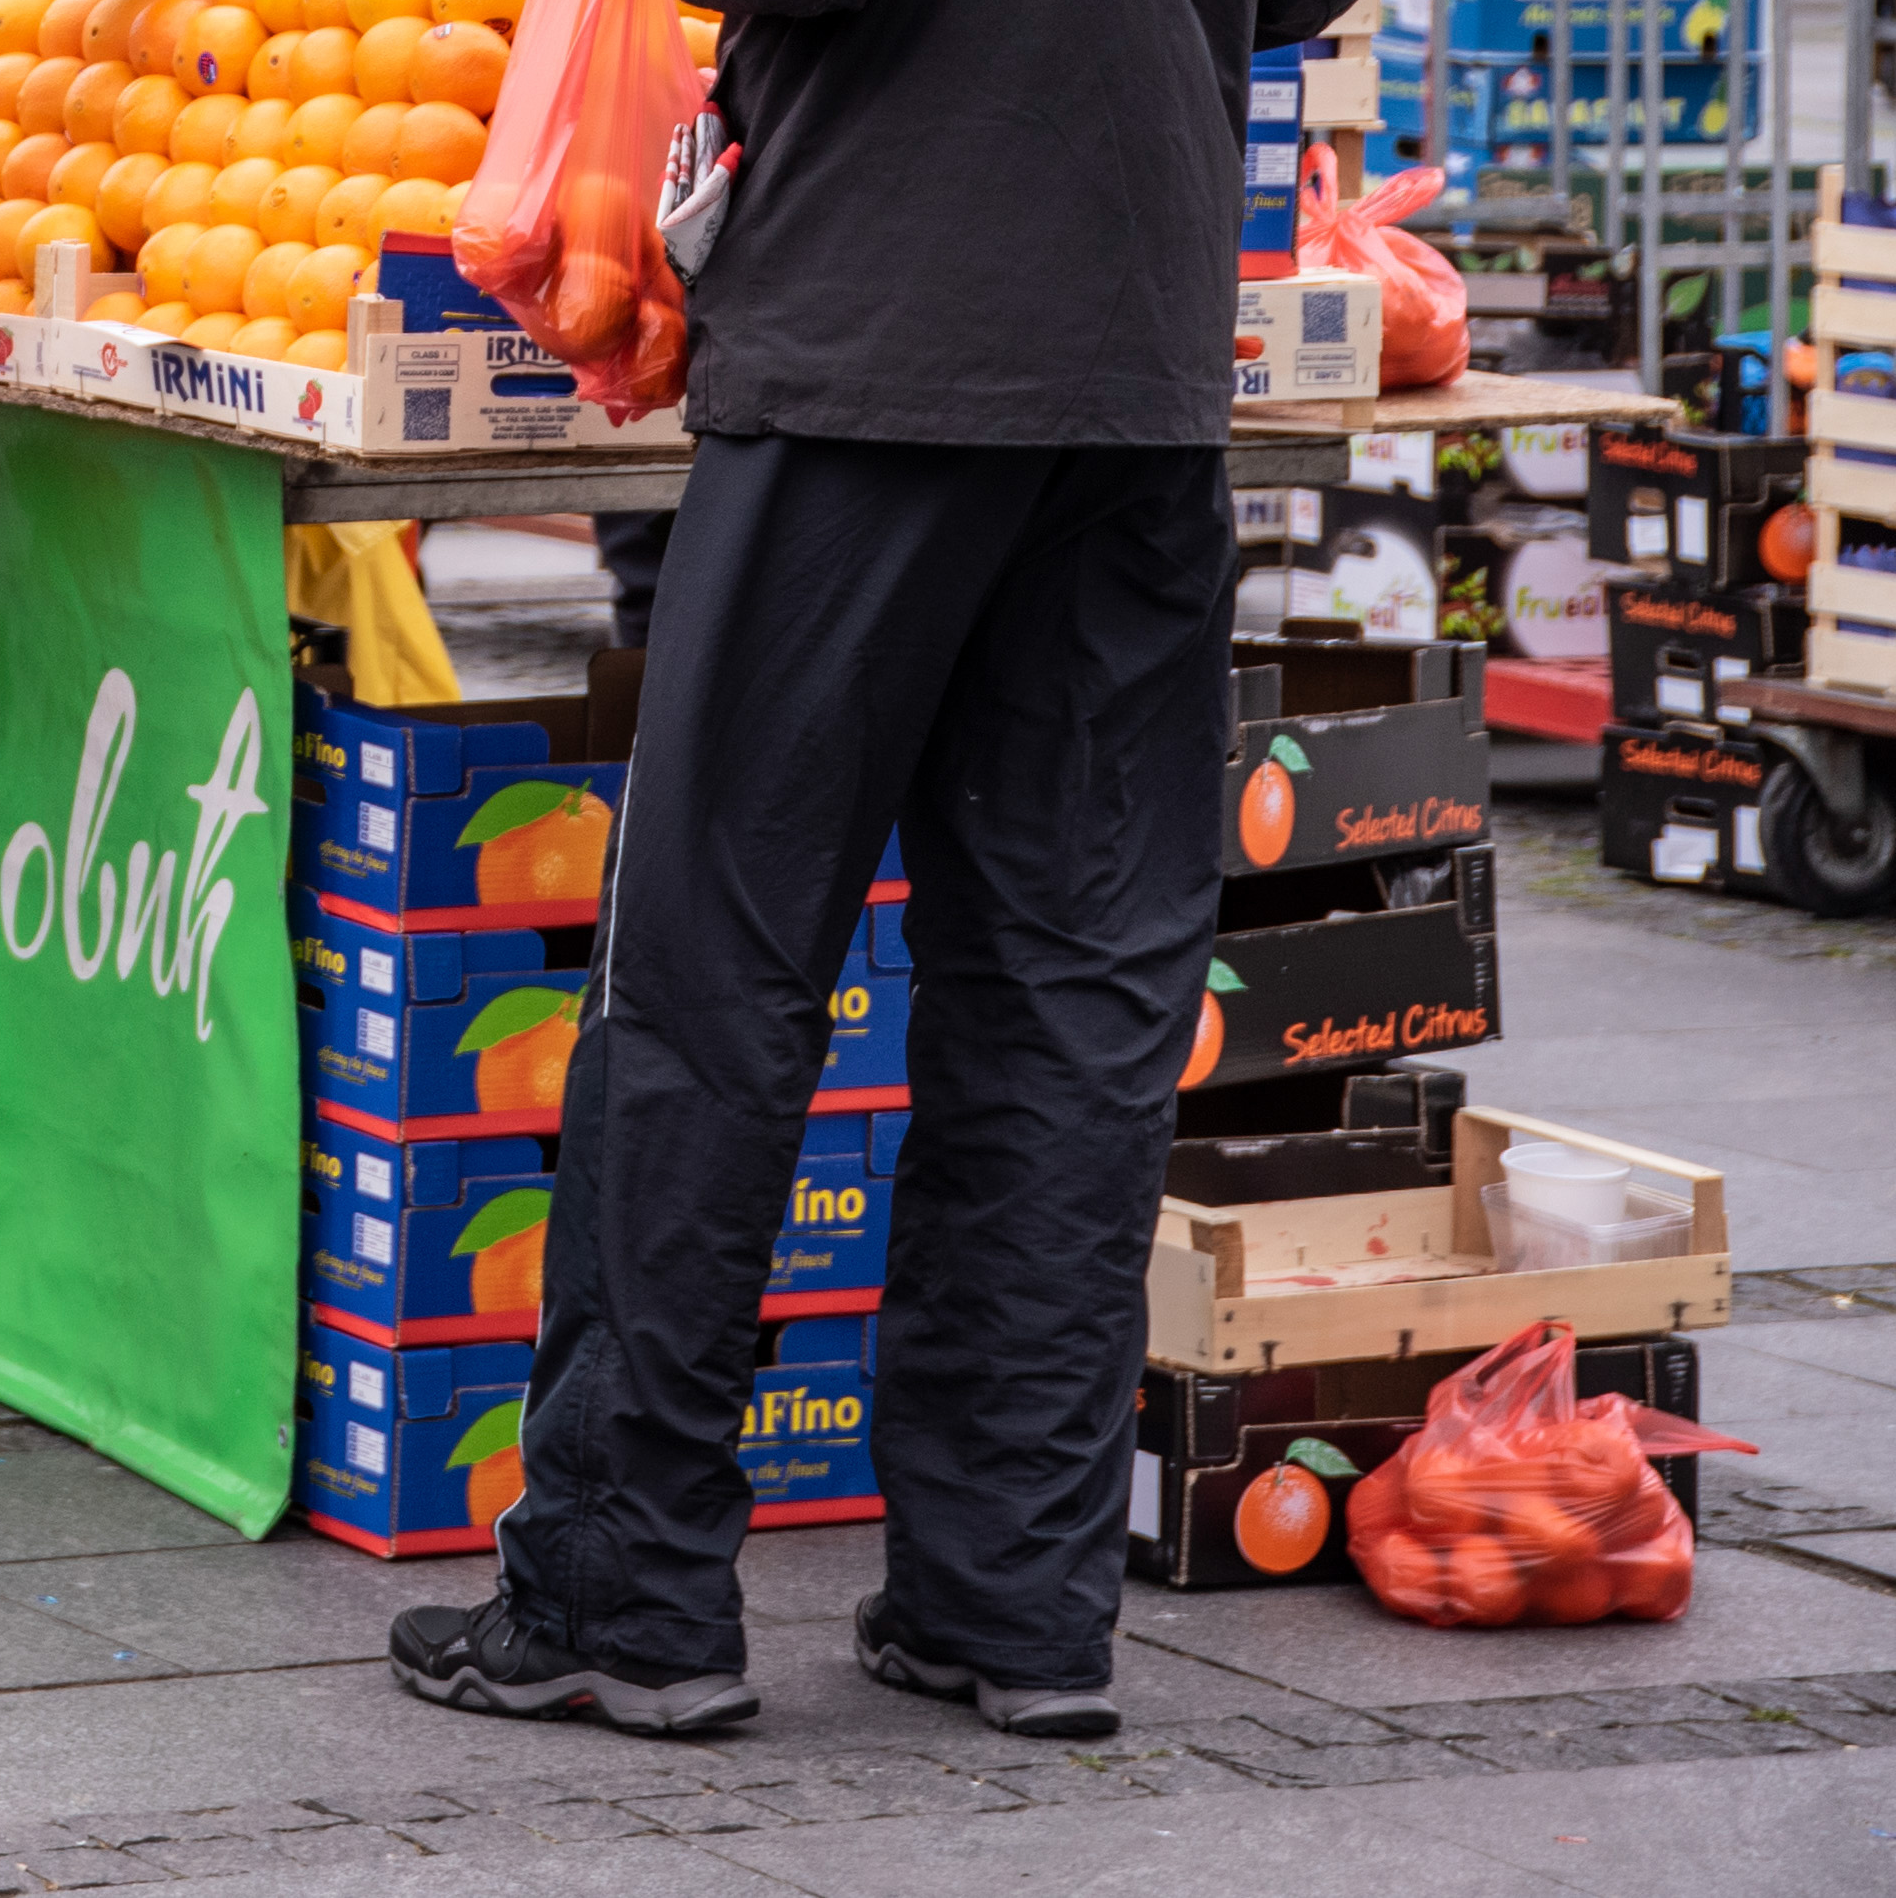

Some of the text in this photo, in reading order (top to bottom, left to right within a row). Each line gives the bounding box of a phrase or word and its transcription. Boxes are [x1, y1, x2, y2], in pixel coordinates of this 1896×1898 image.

[411, 350, 440, 359] CLASS
[1335, 795, 1483, 852] Selected Citrus
[1282, 1002, 1489, 1068] Selected Citrus
